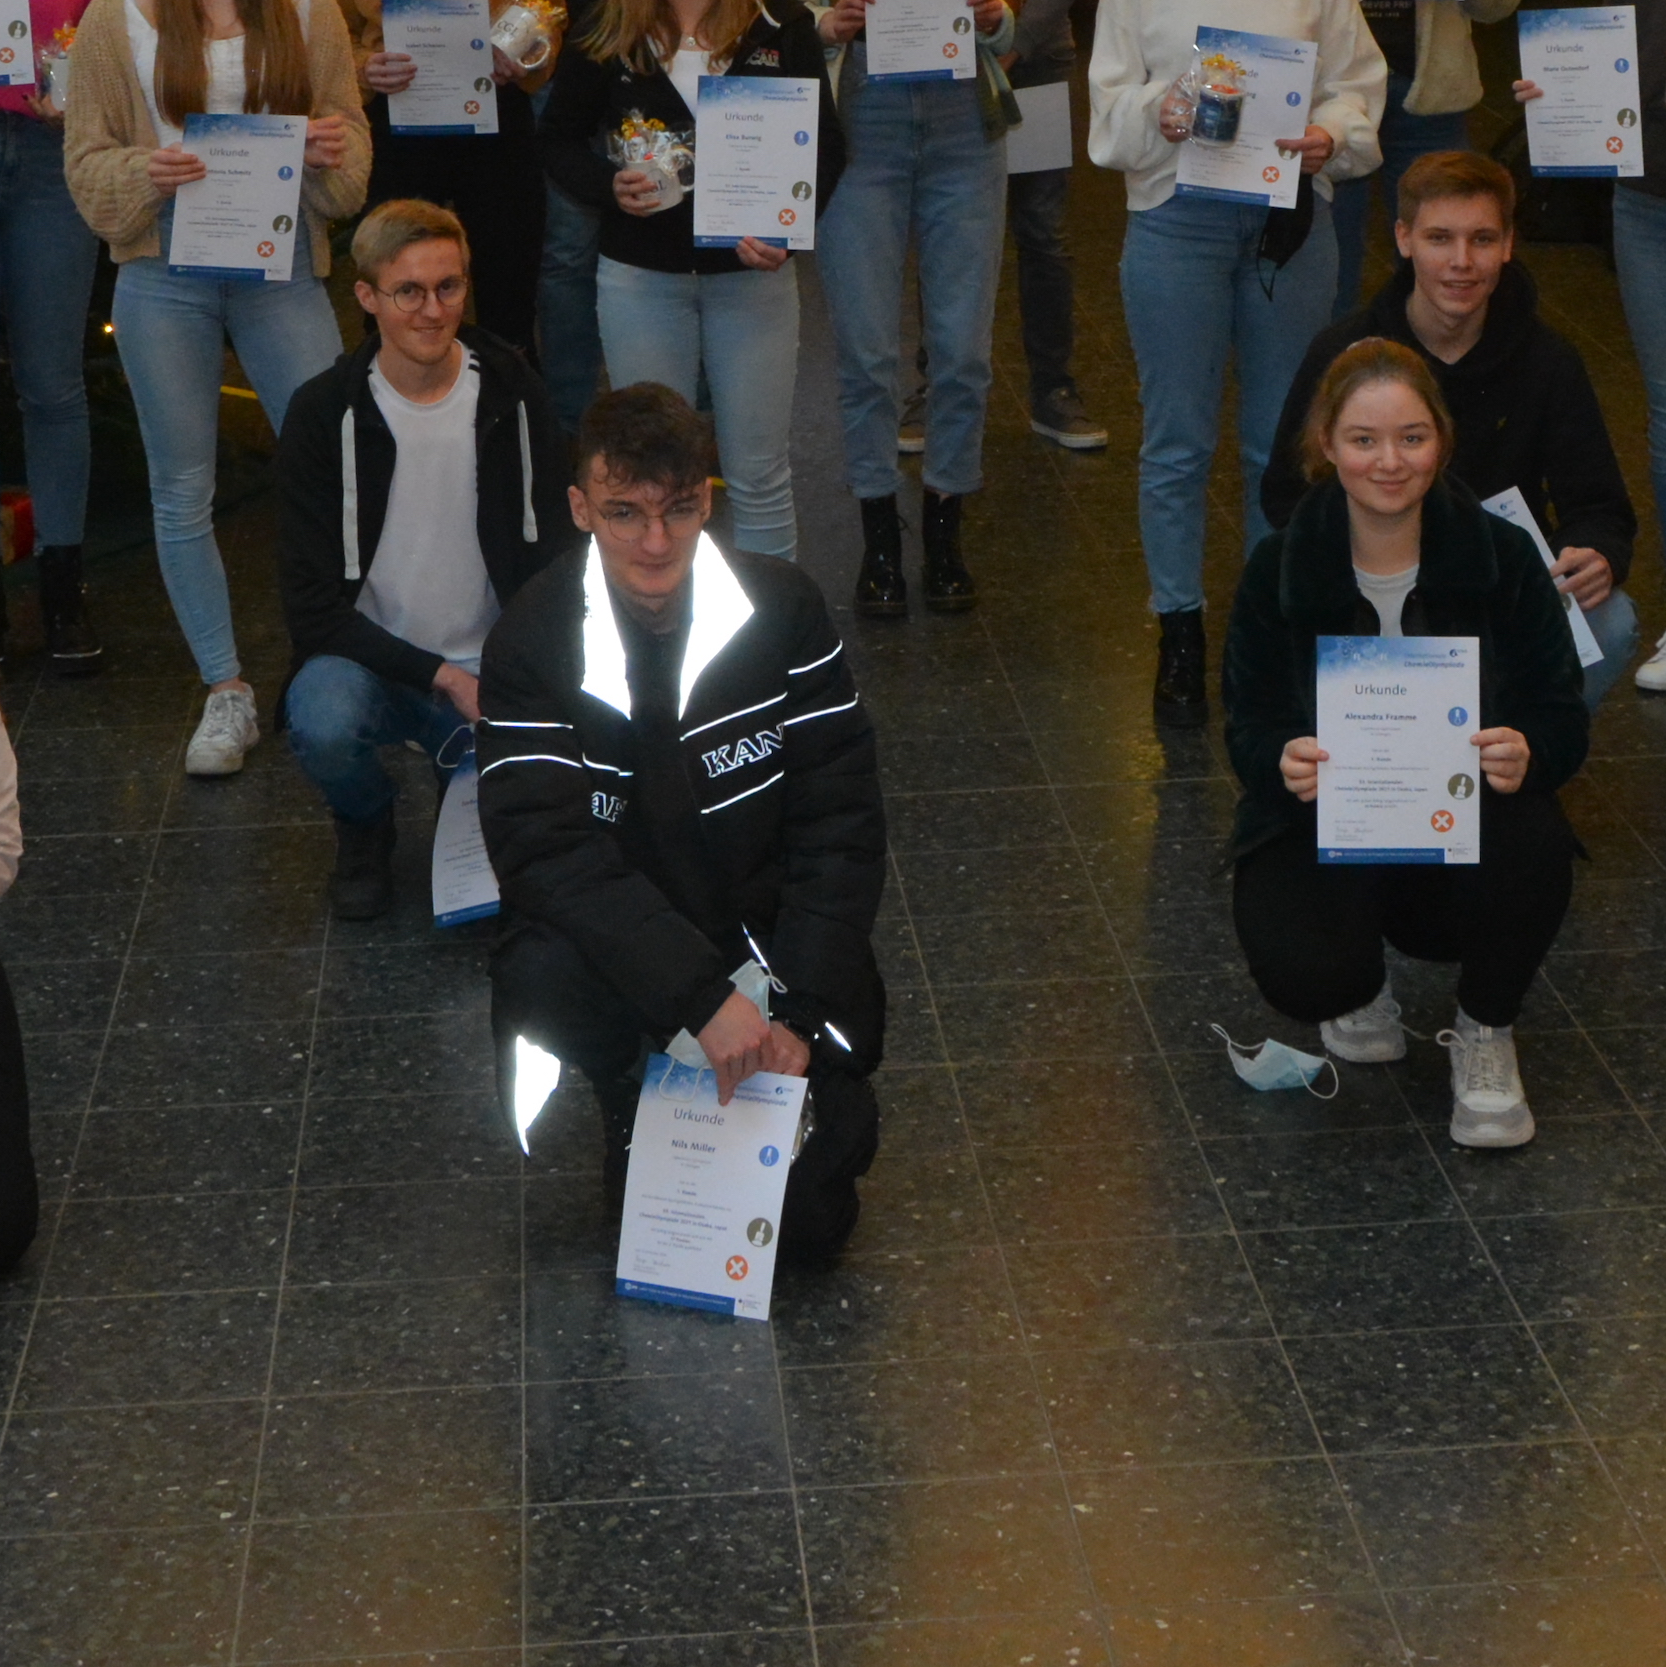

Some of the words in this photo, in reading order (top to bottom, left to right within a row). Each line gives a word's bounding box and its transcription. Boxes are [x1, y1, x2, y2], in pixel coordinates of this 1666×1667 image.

[406, 25, 441, 33] Urkunde
[1545, 43, 1584, 54] Urkunde
[725, 112, 764, 122] Urkunde
[210, 148, 249, 157] Urkunde
[1355, 684, 1407, 696] Urkunde
[1345, 713, 1383, 721] Alexandra
[1385, 713, 1417, 721] Framme
[674, 1108, 725, 1126] Urkunde
[671, 1139, 688, 1150] Nils
[689, 1142, 716, 1154] Miller
